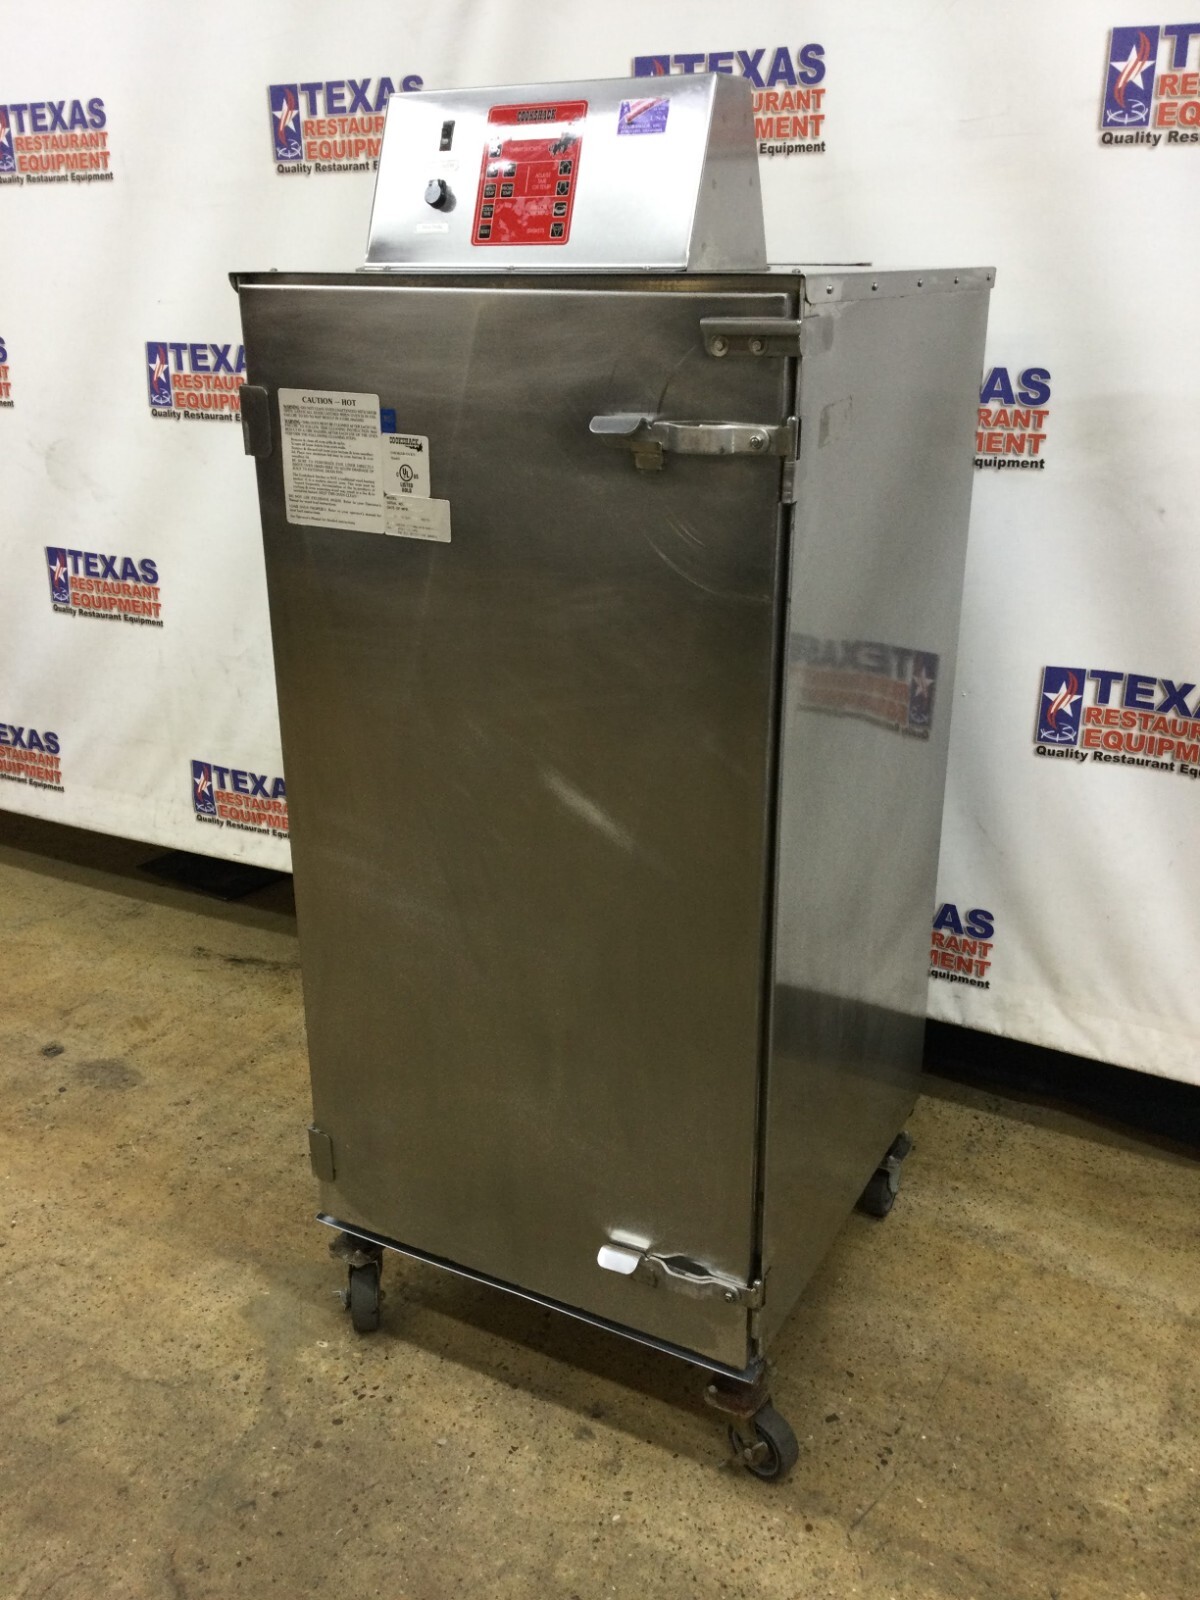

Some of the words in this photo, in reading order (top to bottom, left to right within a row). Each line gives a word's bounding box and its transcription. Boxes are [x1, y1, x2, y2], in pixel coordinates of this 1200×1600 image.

[9, 97, 107, 133] TEXAS
[15, 132, 108, 151] RESTAURANT
[759, 141, 826, 155] Equipment
[1101, 131, 1162, 146] Quality
[18, 151, 110, 172] EQUIPMENT
[277, 163, 312, 175] Quality
[315, 161, 370, 172] Restaurant
[26, 173, 69, 183] Restaurant
[70, 171, 114, 183] Equipment
[302, 396, 333, 405] CAUTION
[341, 398, 357, 407] HOT
[151, 408, 181, 420] Quality
[184, 410, 233, 421] Restaurant
[973, 456, 1046, 470] quipment
[68, 549, 159, 584] TEXAS
[69, 576, 160, 600] RESTAURANT
[72, 592, 161, 618] EQUIPMENT
[52, 604, 77, 617] Quality
[79, 608, 121, 621] Restaurant
[123, 614, 164, 628] Equipment
[1036, 745, 1088, 763] Quality
[1093, 751, 1175, 772] Restaurant
[29, 778, 65, 793] Equipment
[196, 814, 225, 828] Quality
[226, 819, 270, 836] Restaurant
[928, 968, 991, 989] quipment
